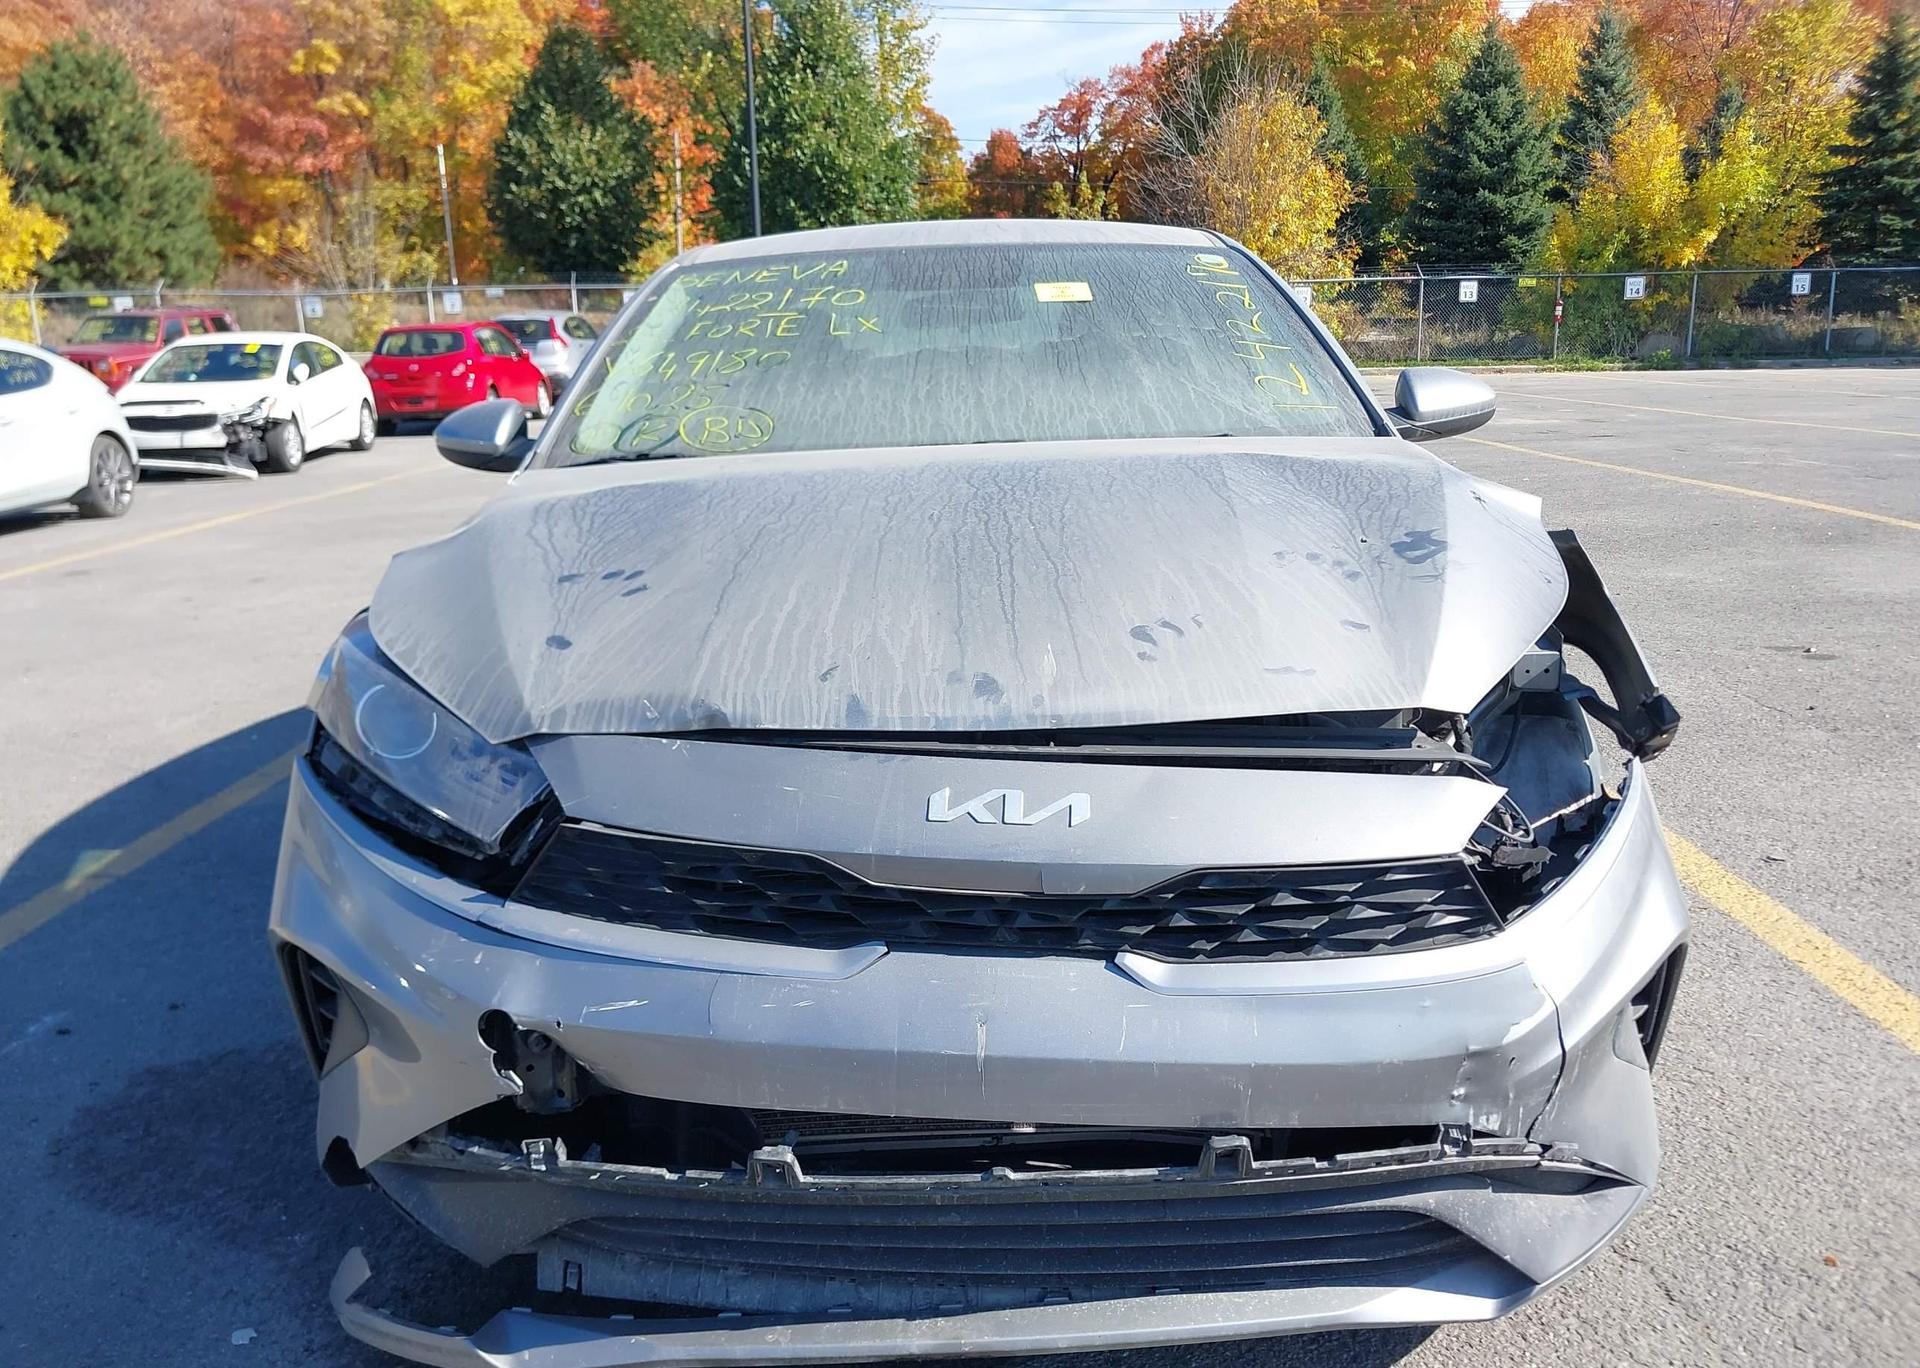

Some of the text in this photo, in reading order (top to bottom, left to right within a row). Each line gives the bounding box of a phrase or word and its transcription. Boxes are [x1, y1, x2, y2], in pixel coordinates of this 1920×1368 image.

[1629, 288, 1640, 296] 14
[1795, 284, 1806, 292] 15
[1463, 290, 1474, 299] 13
[684, 312, 806, 341] FORTE
[926, 786, 1091, 828] KIA
